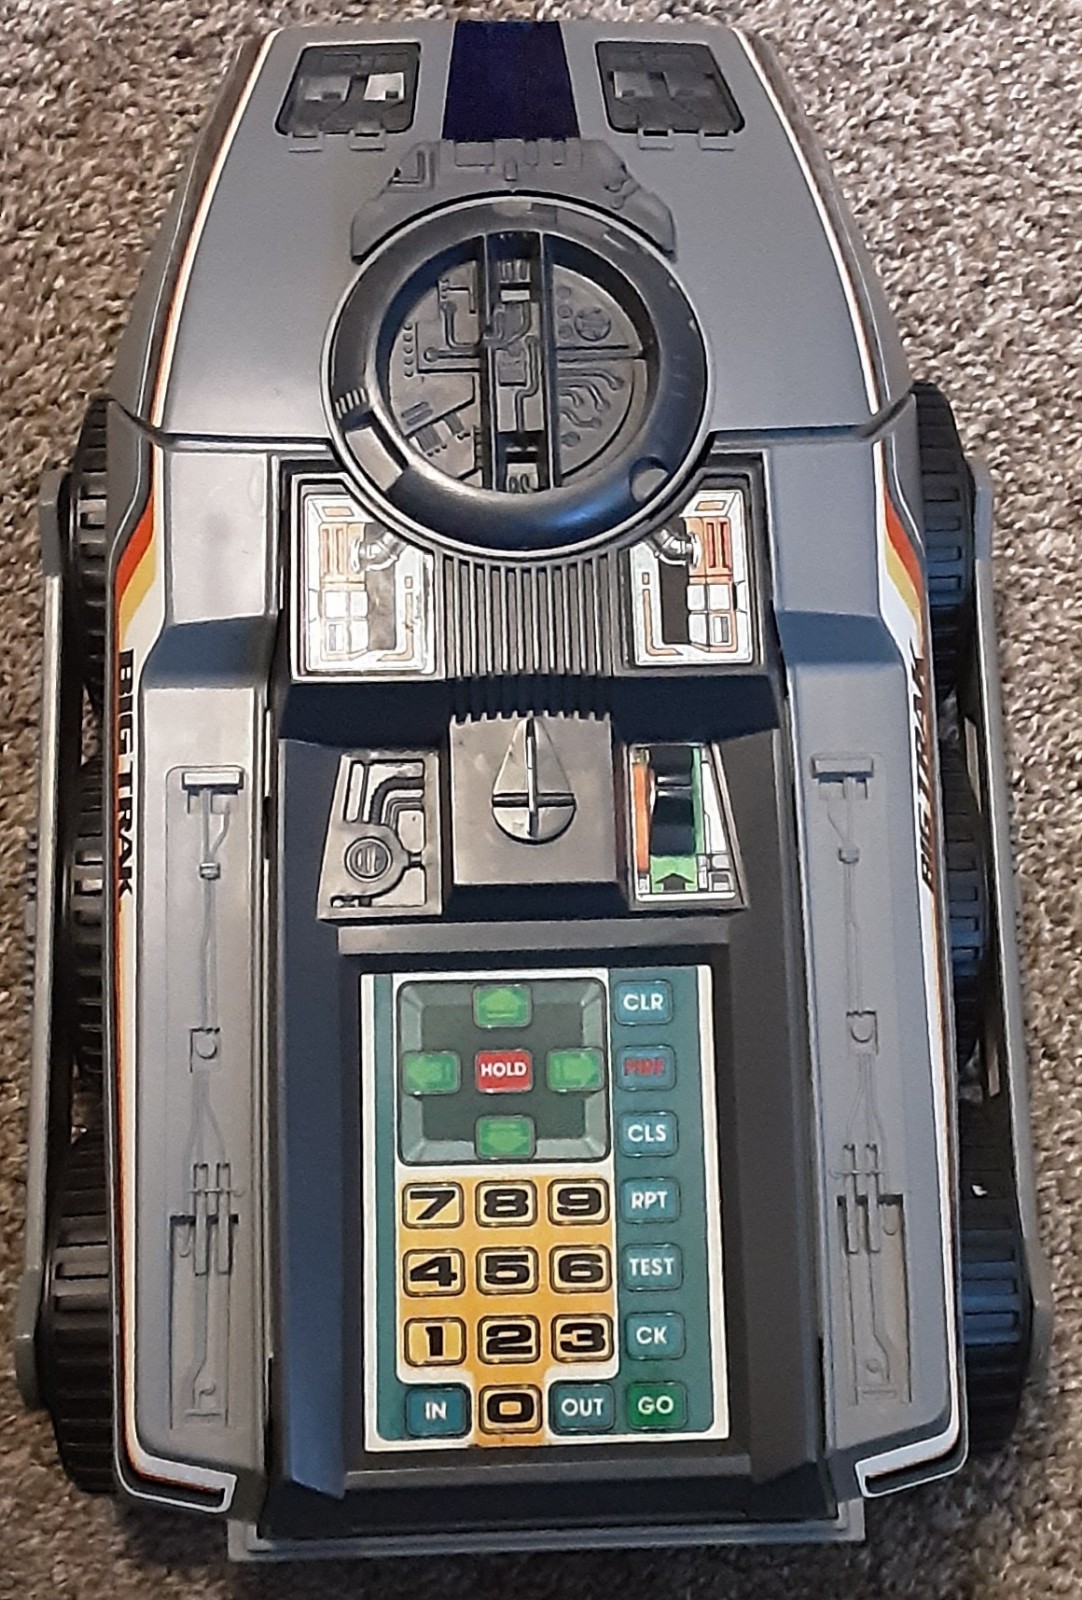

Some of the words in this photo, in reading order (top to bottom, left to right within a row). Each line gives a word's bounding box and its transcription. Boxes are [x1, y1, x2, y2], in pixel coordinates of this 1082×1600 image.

[623, 993, 664, 1011] CLR
[480, 1062, 527, 1078] HOLD
[627, 1124, 667, 1143] CLS
[409, 1190, 456, 1221] 7
[484, 1188, 530, 1218] 8
[557, 1187, 602, 1216] 9
[631, 1191, 668, 1210] RPT
[409, 1255, 458, 1287] 4
[484, 1254, 530, 1286] 5
[558, 1253, 604, 1284] 6
[629, 1258, 674, 1277] TEST
[424, 1325, 444, 1358] 1
[485, 1324, 533, 1356] 2
[559, 1322, 606, 1353] 3
[636, 1326, 668, 1345] CK
[425, 1401, 448, 1421] IN
[561, 1397, 604, 1418] OUT
[637, 1396, 675, 1416] GO
